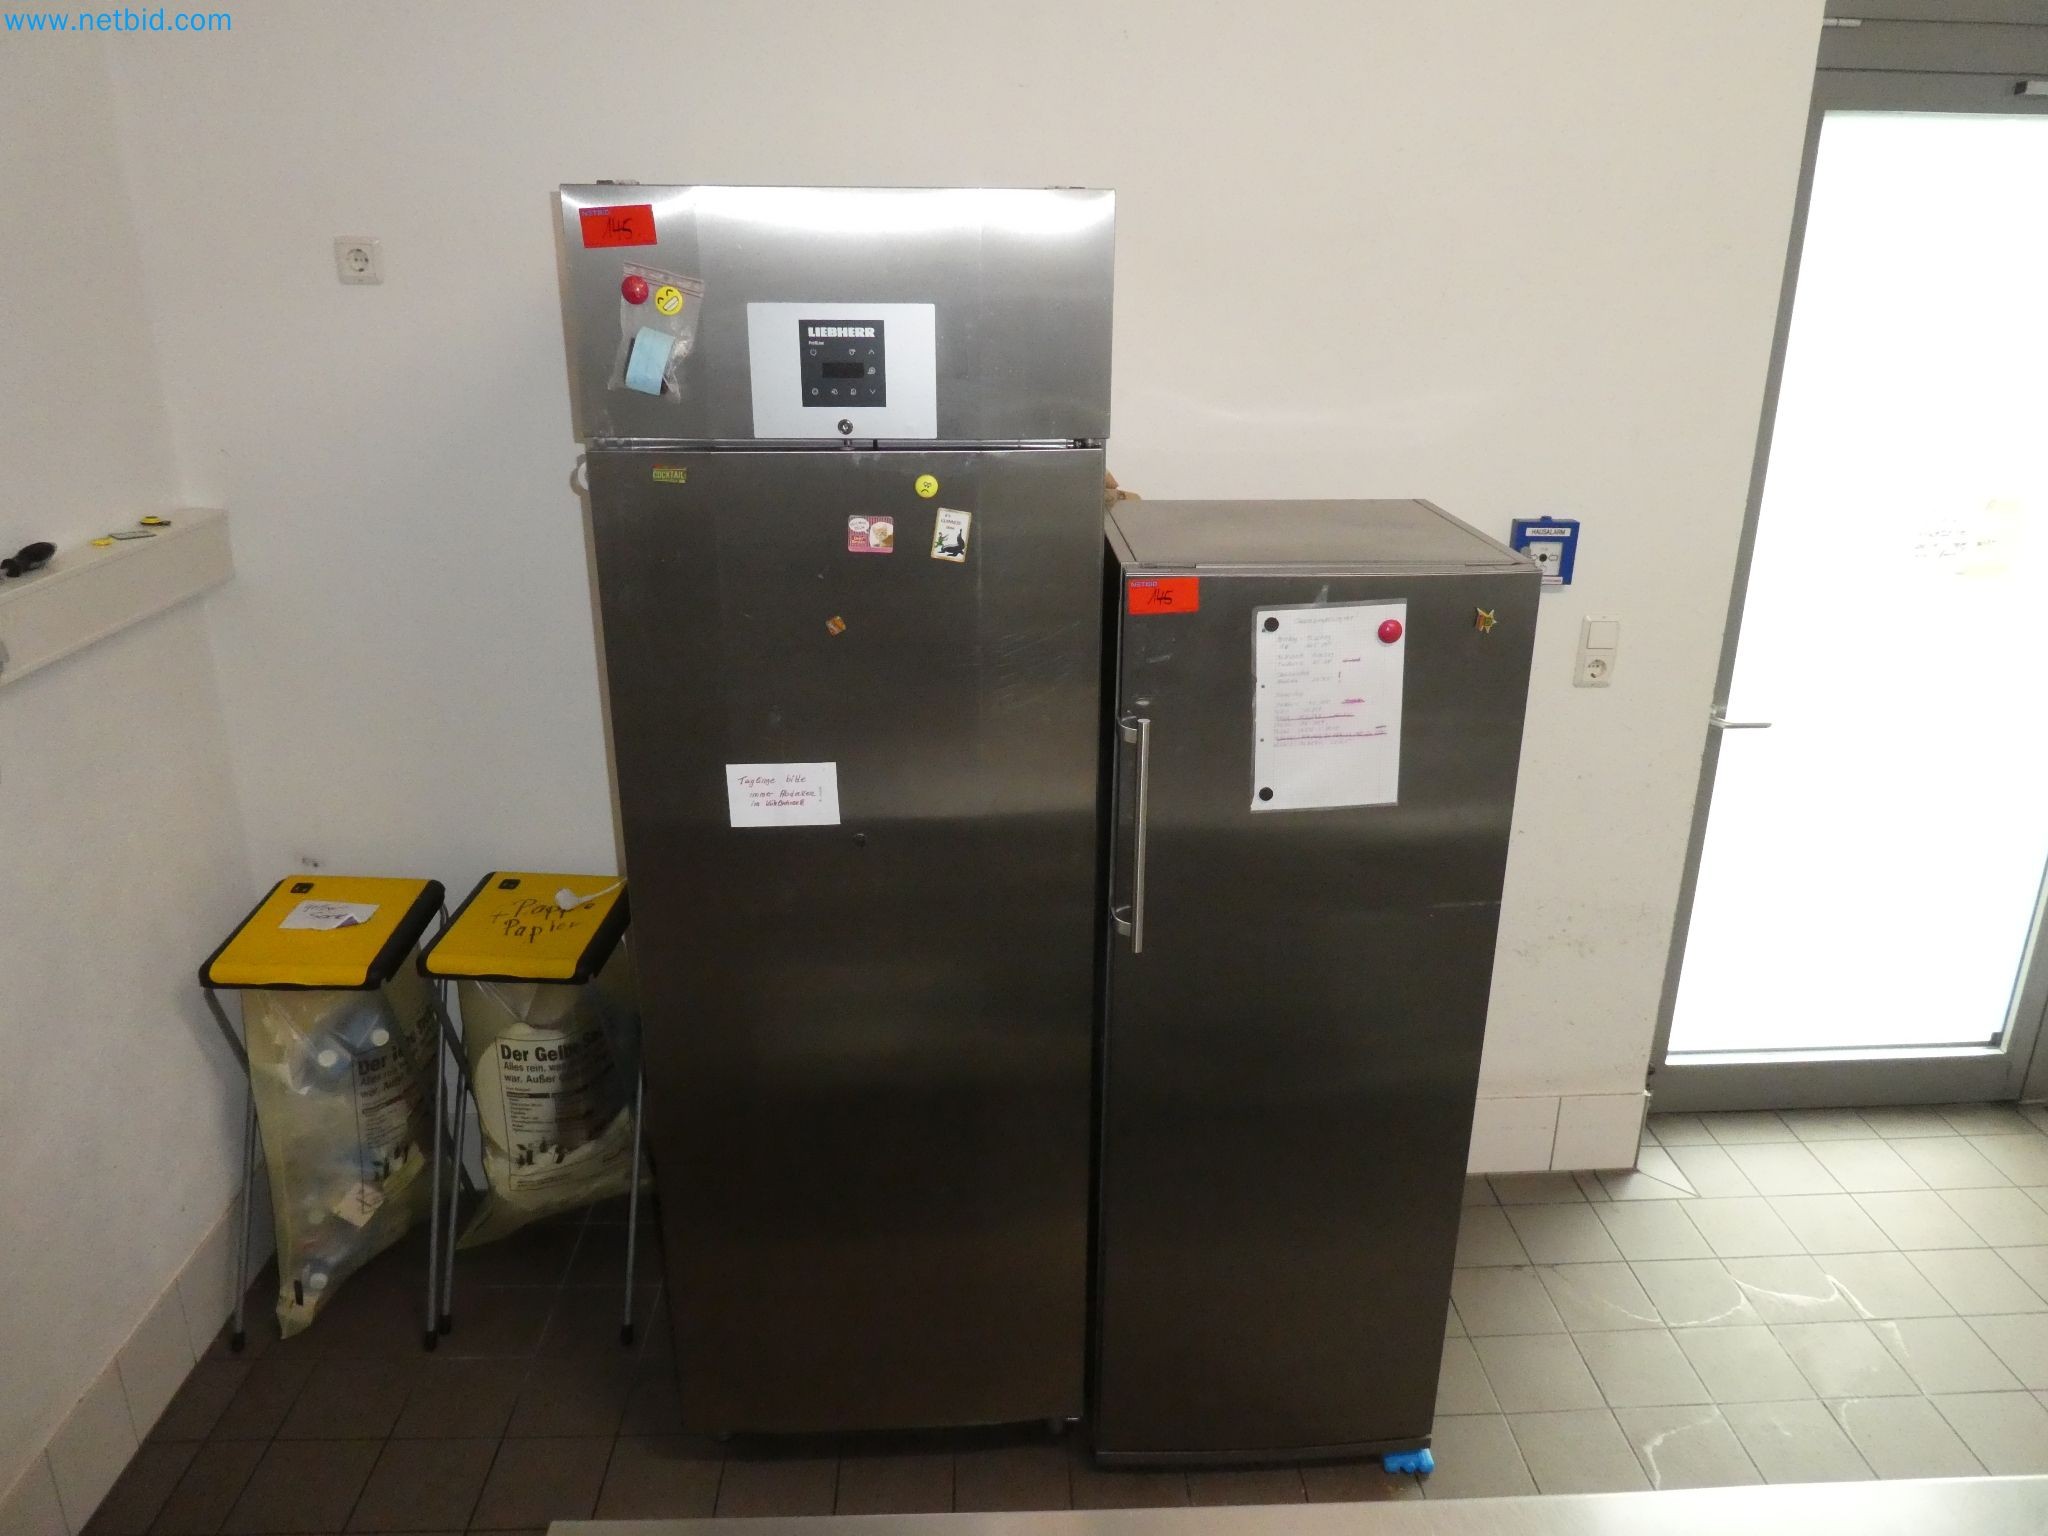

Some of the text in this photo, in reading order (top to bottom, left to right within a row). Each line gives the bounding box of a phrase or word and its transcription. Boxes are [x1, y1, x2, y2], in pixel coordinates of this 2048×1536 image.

[808, 327, 875, 337] LIEBHERR
[503, 918, 583, 944] Papier
[501, 1044, 529, 1062] Der
[504, 1062, 524, 1073] Alles
[505, 1075, 523, 1084] war.
[526, 1074, 556, 1085] Außer
